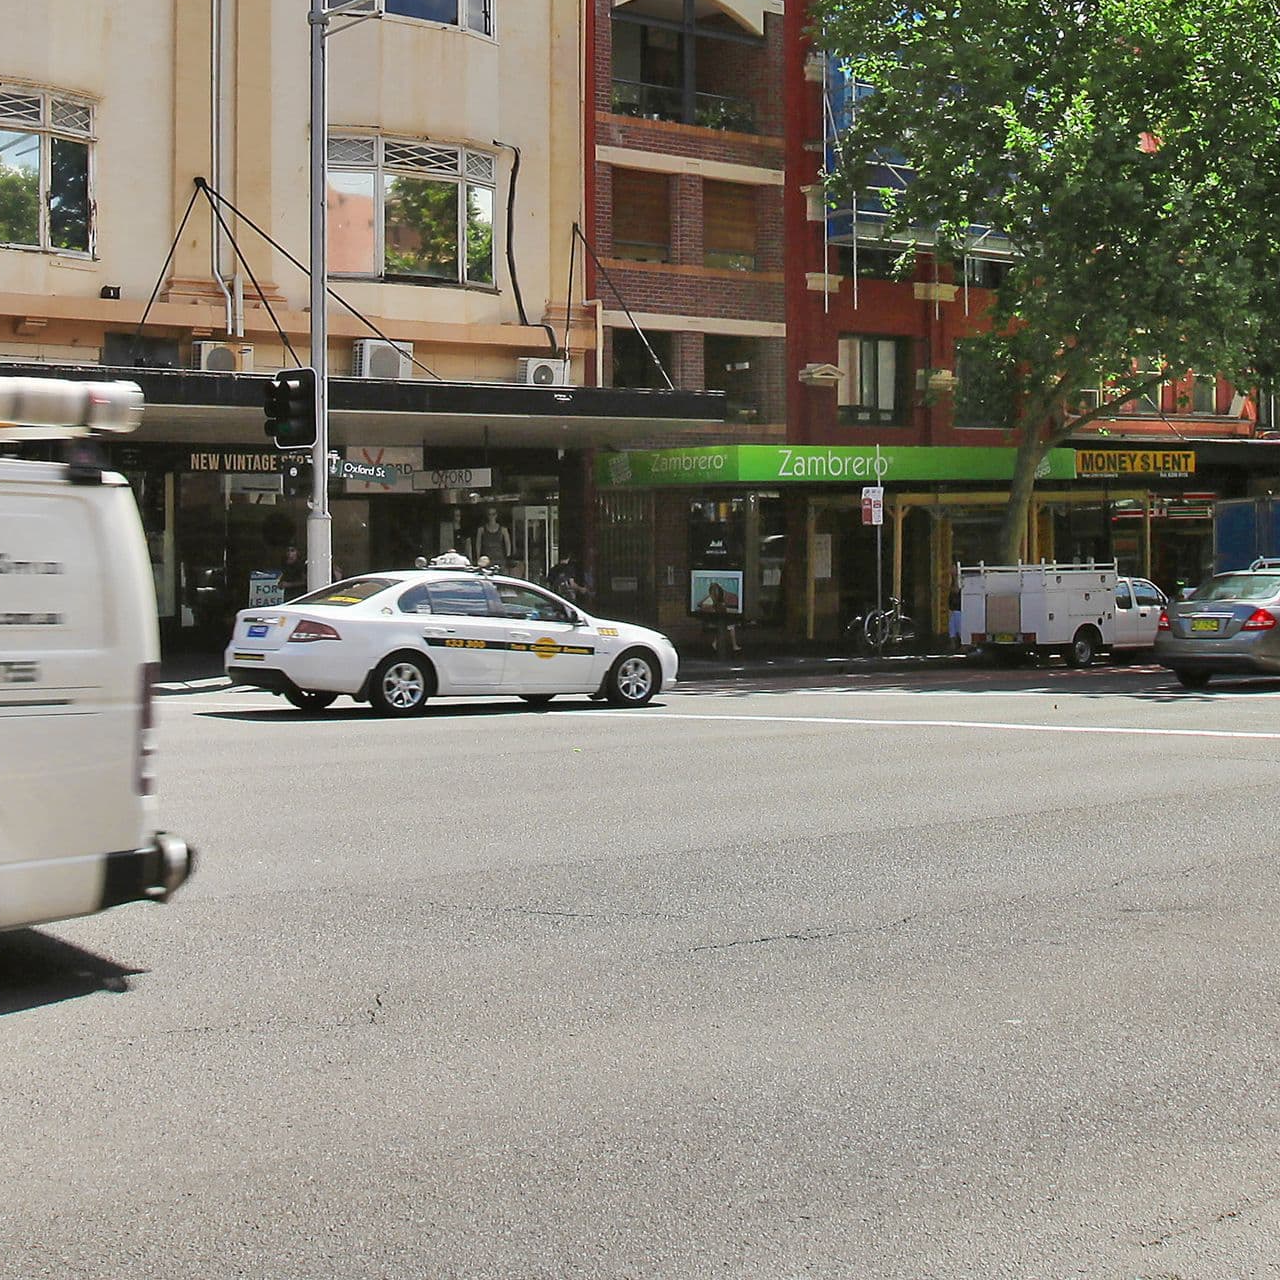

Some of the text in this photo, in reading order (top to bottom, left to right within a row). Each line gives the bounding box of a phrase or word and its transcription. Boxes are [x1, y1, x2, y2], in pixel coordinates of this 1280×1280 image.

[190, 453, 220, 471] NEW
[223, 454, 277, 471] VINTAGE
[344, 462, 386, 478] Oxford St
[651, 453, 725, 473] Zambrero
[777, 450, 888, 477] Zambrero
[431, 470, 473, 488] OXFORD
[256, 585, 278, 594] FOR
[250, 597, 283, 608] LEASE
